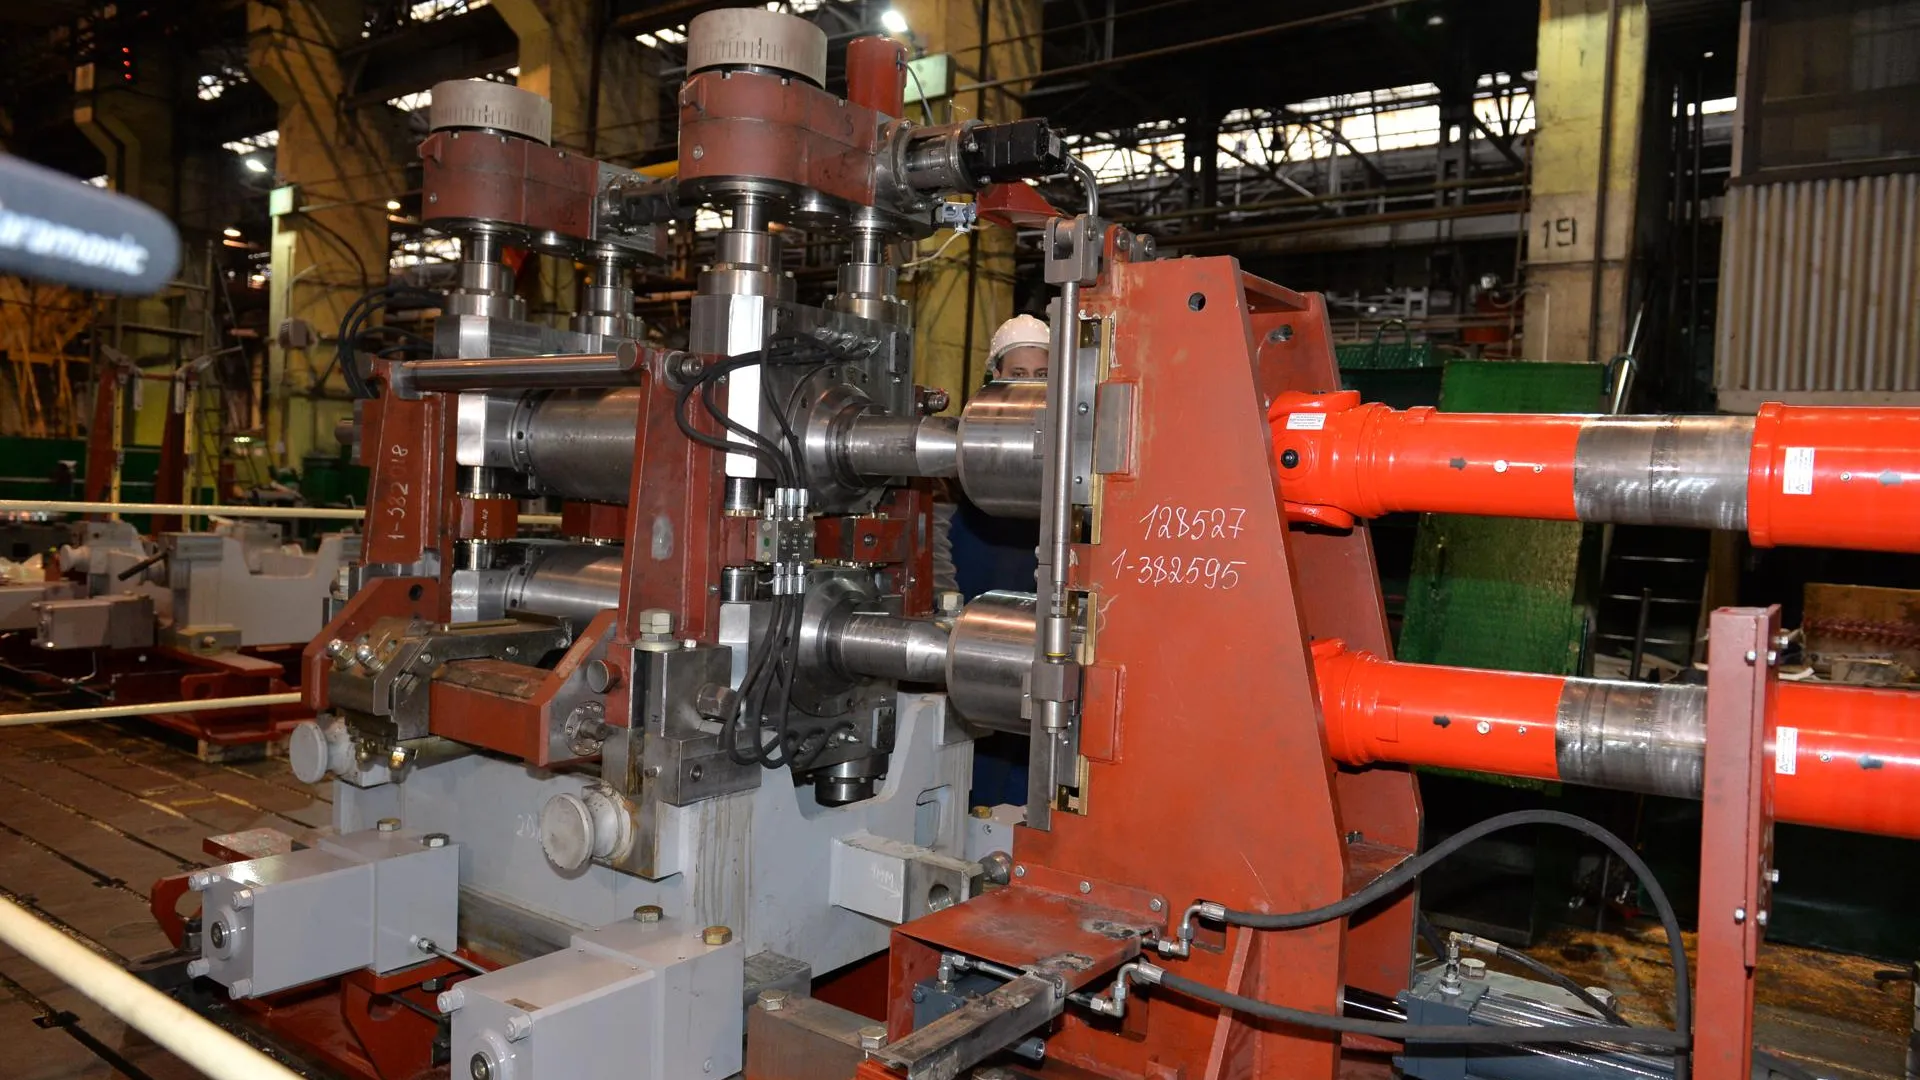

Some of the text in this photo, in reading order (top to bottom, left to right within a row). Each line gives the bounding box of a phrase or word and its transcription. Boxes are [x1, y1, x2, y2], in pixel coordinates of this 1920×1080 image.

[0, 204, 149, 276] aramonic
[1542, 217, 1577, 249] 19
[1140, 504, 1246, 540] 128527
[1111, 548, 1247, 589] 1-382595
